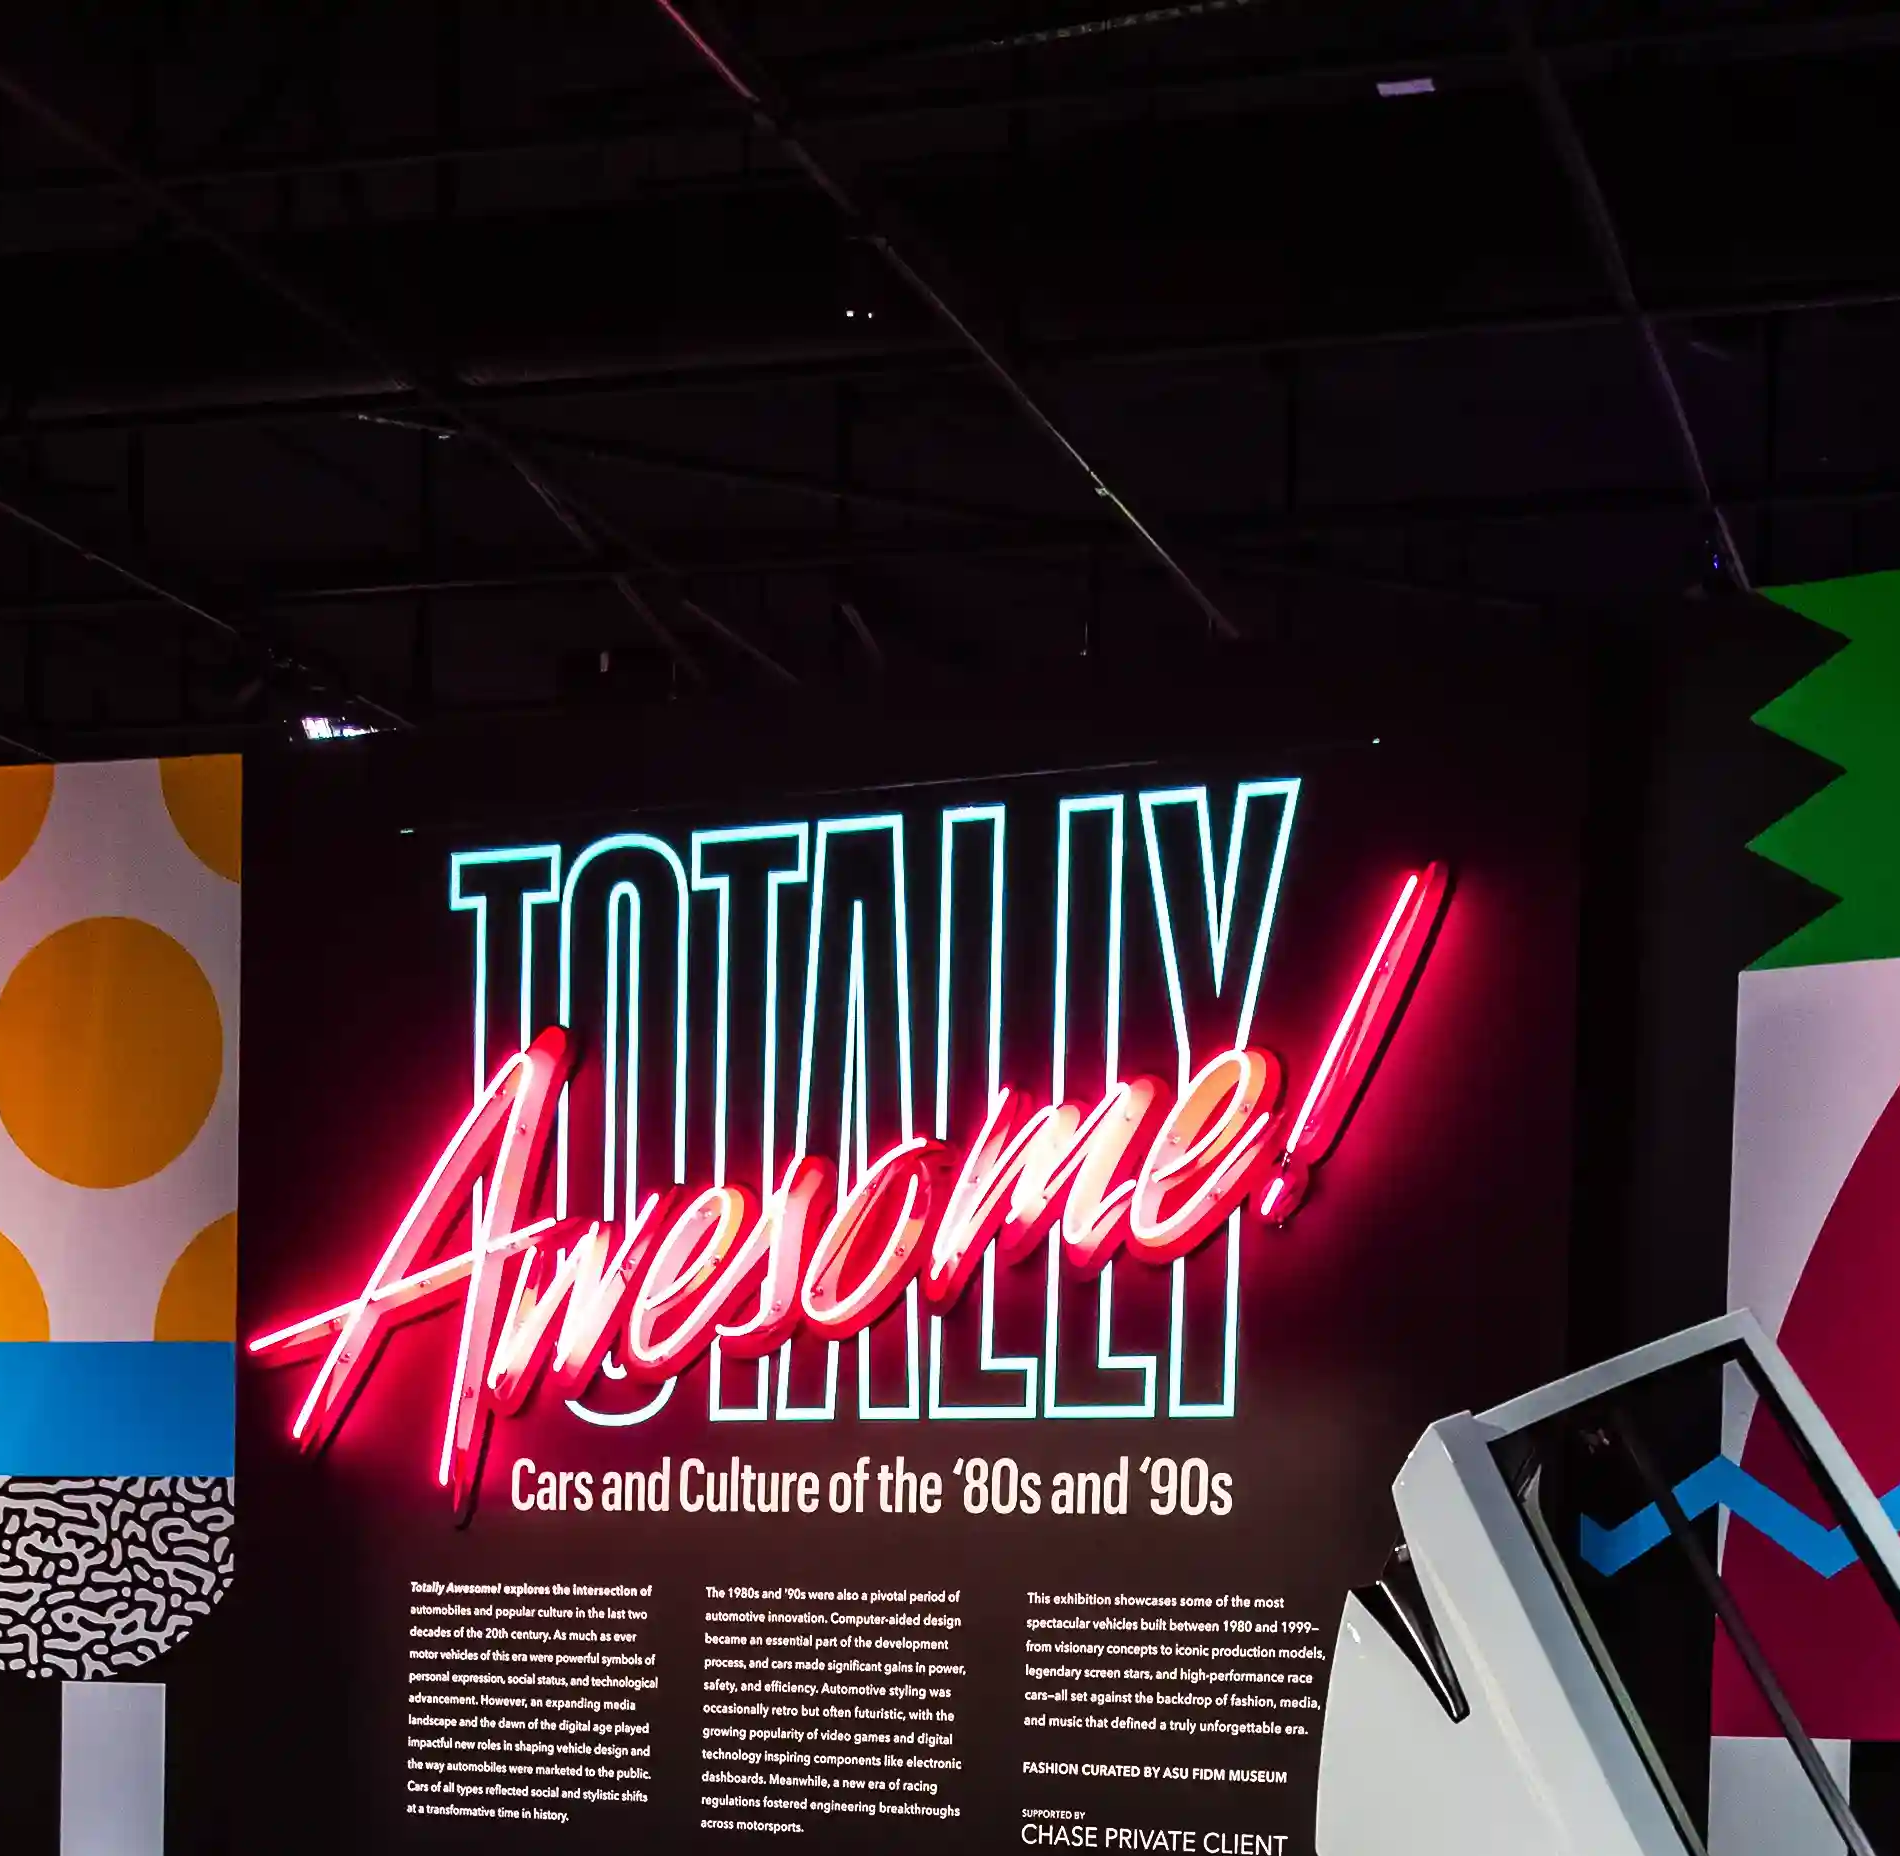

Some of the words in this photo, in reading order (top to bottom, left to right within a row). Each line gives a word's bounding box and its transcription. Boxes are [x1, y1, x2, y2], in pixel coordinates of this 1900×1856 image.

[449, 776, 1302, 1427] TOTALLY
[249, 861, 1447, 1512] Awesome!
[511, 1457, 593, 1512] Cars
[602, 1456, 670, 1511] and
[680, 1456, 819, 1513] Culture
[829, 1456, 870, 1513] of
[877, 1456, 942, 1513] the
[1051, 1456, 1128, 1514] and
[410, 1581, 445, 1596] Totally
[503, 1582, 550, 1597] explores
[552, 1583, 571, 1595] the
[572, 1583, 638, 1597] intersection
[640, 1585, 653, 1597] of
[705, 1586, 726, 1598] The
[728, 1587, 760, 1599] 1980s
[761, 1587, 782, 1600] and
[808, 1591, 835, 1600] were
[836, 1588, 859, 1601] also
[861, 1592, 868, 1601] a
[870, 1589, 907, 1604] pivotal
[909, 1590, 946, 1605] period
[947, 1590, 961, 1603] of
[1027, 1591, 1051, 1604] This
[1053, 1592, 1111, 1606] exhibition
[1114, 1593, 1177, 1607] showcases
[1180, 1597, 1213, 1607] some
[1215, 1594, 1229, 1607] of
[1231, 1594, 1251, 1608] the
[1254, 1597, 1284, 1608] most
[409, 1625, 451, 1638] decades
[453, 1626, 465, 1638] of
[466, 1626, 483, 1639] the
[485, 1627, 508, 1639] 20th
[553, 1629, 567, 1641] As
[569, 1629, 598, 1641] much
[599, 1633, 612, 1642] as
[613, 1633, 637, 1642] ever
[1026, 1616, 1091, 1631] spectacular
[1092, 1617, 1138, 1630] vehicles
[1140, 1618, 1167, 1631] built
[1169, 1618, 1219, 1632] between
[1223, 1620, 1252, 1632] 1980
[1255, 1620, 1278, 1633] and
[705, 1632, 747, 1645] became
[749, 1636, 763, 1645] an
[765, 1634, 813, 1647] essential
[815, 1637, 838, 1650] part
[840, 1635, 852, 1648] of
[854, 1636, 872, 1648] the
[874, 1636, 949, 1652] development
[1025, 1639, 1052, 1652] from
[1054, 1641, 1105, 1657] visionary
[1106, 1644, 1158, 1658] concepts
[1160, 1644, 1173, 1656] to
[1175, 1643, 1209, 1657] iconic
[1211, 1644, 1276, 1660] production
[1278, 1646, 1326, 1661] models,
[408, 1671, 450, 1684] personal
[507, 1673, 536, 1685] social
[570, 1675, 589, 1686] and
[591, 1675, 658, 1691] technological
[1025, 1664, 1082, 1680] legendary
[1084, 1669, 1121, 1679] screen
[1124, 1668, 1153, 1680] stars,
[1155, 1668, 1177, 1680] and
[1180, 1668, 1285, 1684] high-performance
[1287, 1674, 1313, 1684] race
[703, 1678, 738, 1694] safety,
[740, 1680, 762, 1692] and
[764, 1680, 819, 1696] efficiency.
[821, 1682, 886, 1696] Automotive
[889, 1684, 926, 1700] styling
[929, 1688, 951, 1698] was
[408, 1714, 457, 1729] landscape
[458, 1716, 478, 1728] and
[480, 1716, 496, 1728] the
[498, 1717, 526, 1729] dawn
[527, 1718, 539, 1730] of
[540, 1719, 557, 1730] the
[558, 1719, 591, 1734] digital
[592, 1724, 613, 1735] age
[614, 1721, 649, 1736] played
[1024, 1714, 1046, 1726] and
[1049, 1716, 1083, 1728] music
[1085, 1715, 1109, 1728] that
[1110, 1716, 1156, 1730] defined
[1160, 1721, 1167, 1730] a
[1169, 1718, 1196, 1735] truly
[1200, 1719, 1282, 1736] unforgettable
[1285, 1725, 1308, 1735] era.
[702, 1726, 747, 1741] growing
[749, 1727, 804, 1742] popularity
[806, 1728, 819, 1740] of
[820, 1729, 851, 1742] video
[854, 1733, 891, 1745] games
[893, 1732, 914, 1744] and
[917, 1732, 953, 1748] digital
[407, 1758, 423, 1770] the
[425, 1762, 445, 1774] way
[447, 1761, 507, 1773] automobiles
[509, 1765, 533, 1775] were
[535, 1764, 583, 1776] marketed
[584, 1767, 596, 1777] to
[597, 1766, 615, 1778] the
[1023, 1761, 1078, 1775] FASHION
[1081, 1764, 1140, 1777] CURATED
[1144, 1766, 1160, 1778] BY
[1162, 1767, 1189, 1780] ASU
[1192, 1768, 1225, 1780] FIDM
[1229, 1769, 1287, 1783] MUSEUM
[701, 1770, 766, 1784] dashboards.
[769, 1773, 831, 1789] Meanwhile,
[833, 1779, 840, 1788] a
[842, 1780, 866, 1789] new
[868, 1780, 886, 1790] era
[888, 1778, 901, 1790] of
[903, 1780, 937, 1795] racing
[406, 1804, 416, 1813] at
[418, 1805, 424, 1814] a
[426, 1804, 495, 1817] transformative
[497, 1807, 520, 1819] time
[522, 1808, 531, 1818] in
[1022, 1809, 1072, 1819] SUPPORTED
[1074, 1811, 1085, 1820] BY
[700, 1820, 734, 1829] across
[736, 1820, 804, 1834] motorsports.
[1021, 1824, 1098, 1847] CHASE
[1106, 1828, 1196, 1852] PRIVATE
[1203, 1832, 1288, 1856] CLIENT
